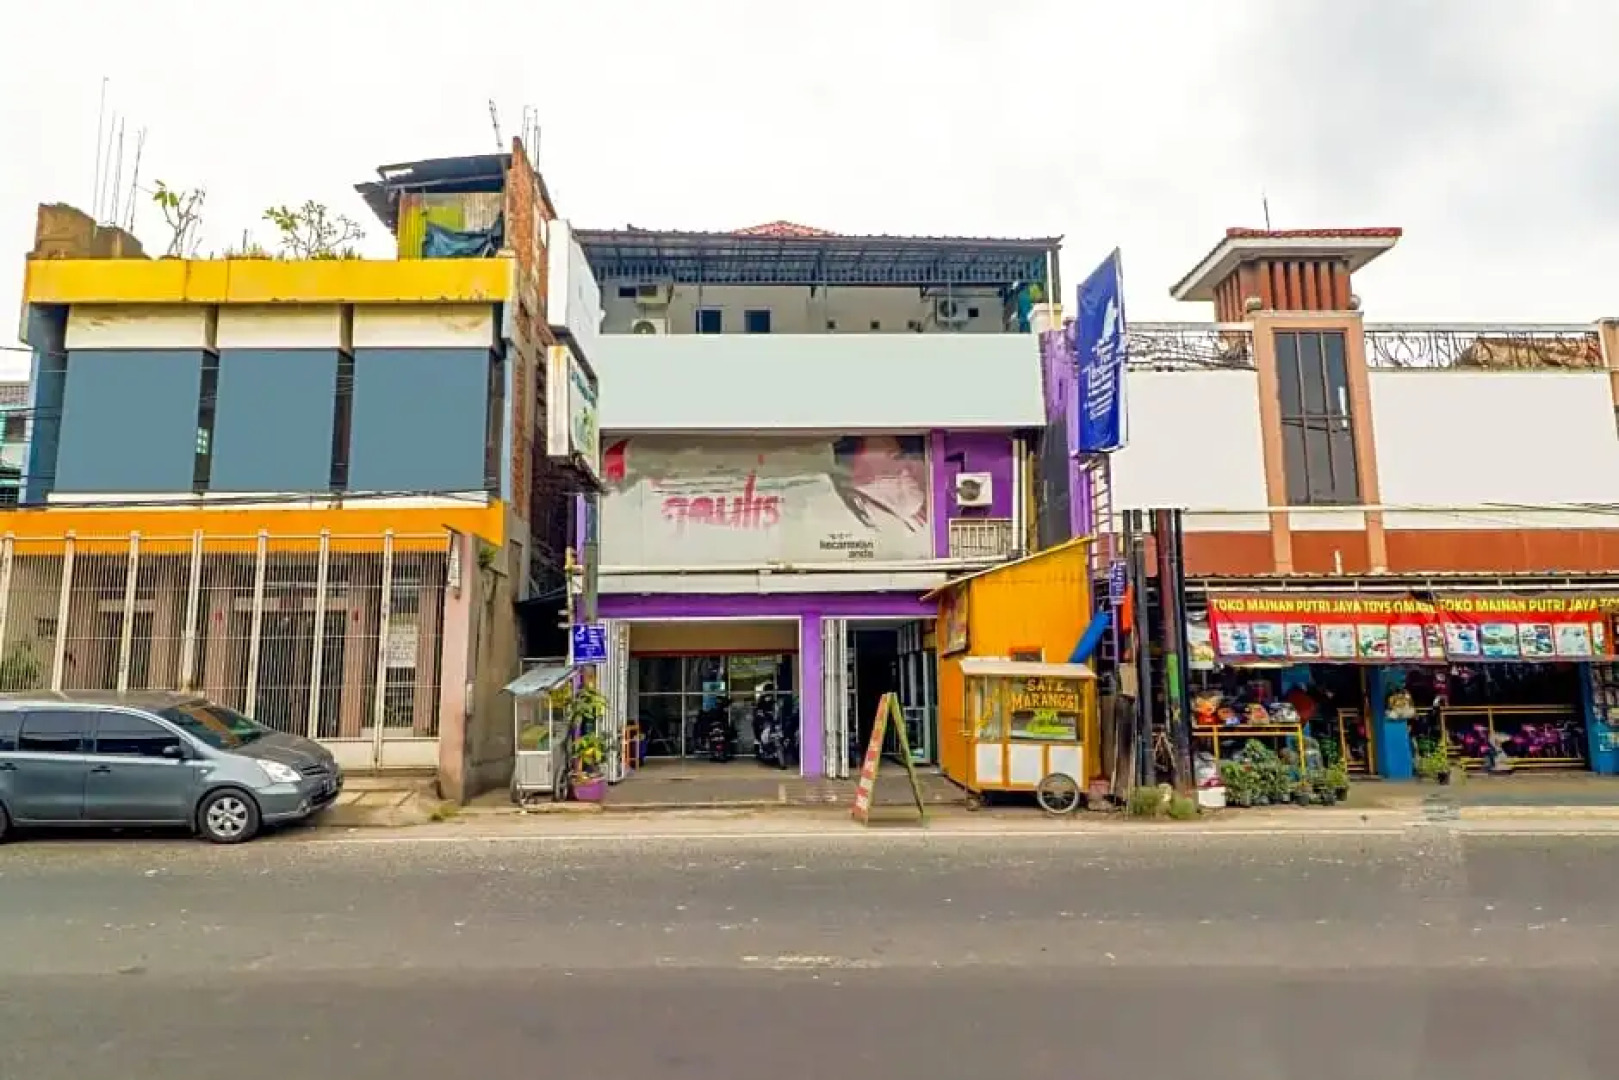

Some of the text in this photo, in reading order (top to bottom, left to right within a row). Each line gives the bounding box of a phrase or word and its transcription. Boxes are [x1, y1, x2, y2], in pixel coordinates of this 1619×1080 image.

[1210, 599, 1244, 611] TOKO
[1247, 599, 1294, 612] MAINAN
[1297, 600, 1330, 613] PUTRI
[1333, 600, 1361, 613] JAYA
[1363, 600, 1391, 613] TOYS
[1475, 599, 1526, 612] MAINAN
[1529, 599, 1564, 612] PUTRI
[1568, 599, 1598, 612] JAYA
